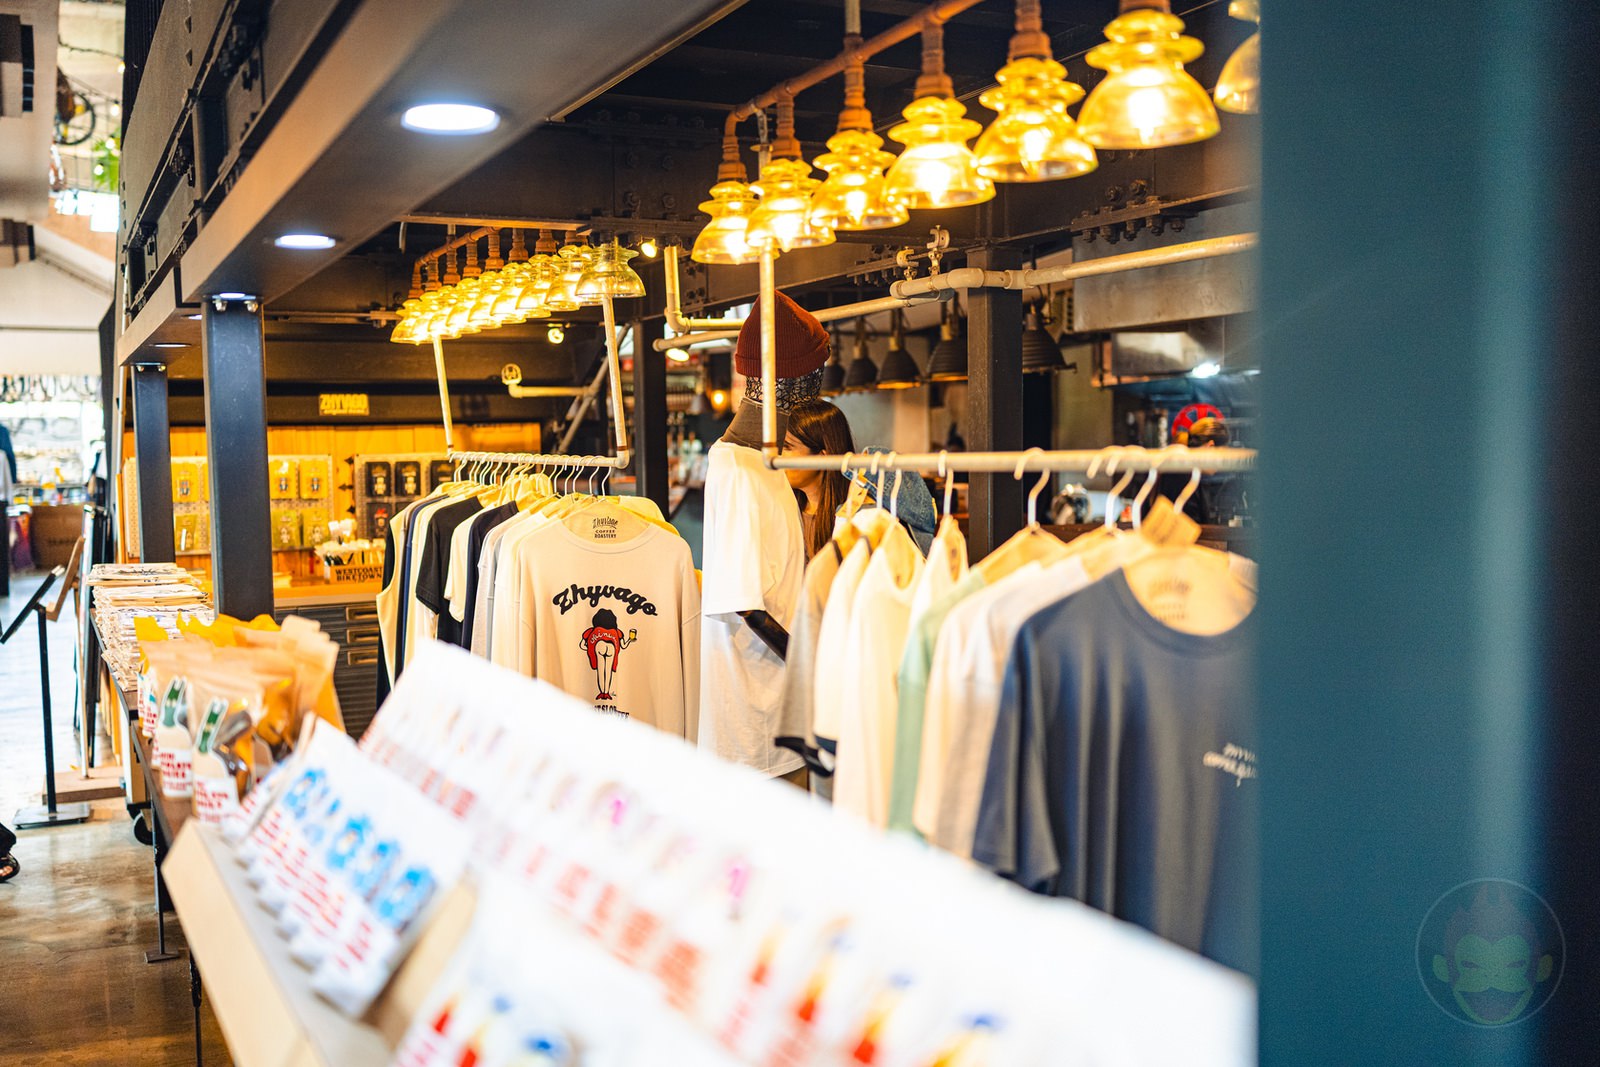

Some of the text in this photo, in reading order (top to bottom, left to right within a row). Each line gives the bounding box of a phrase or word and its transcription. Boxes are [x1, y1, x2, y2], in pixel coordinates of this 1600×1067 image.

[335, 566, 383, 575] WESTCOAST
[336, 573, 382, 581] BIKETOWN
[552, 583, 658, 616] Zhyvago
